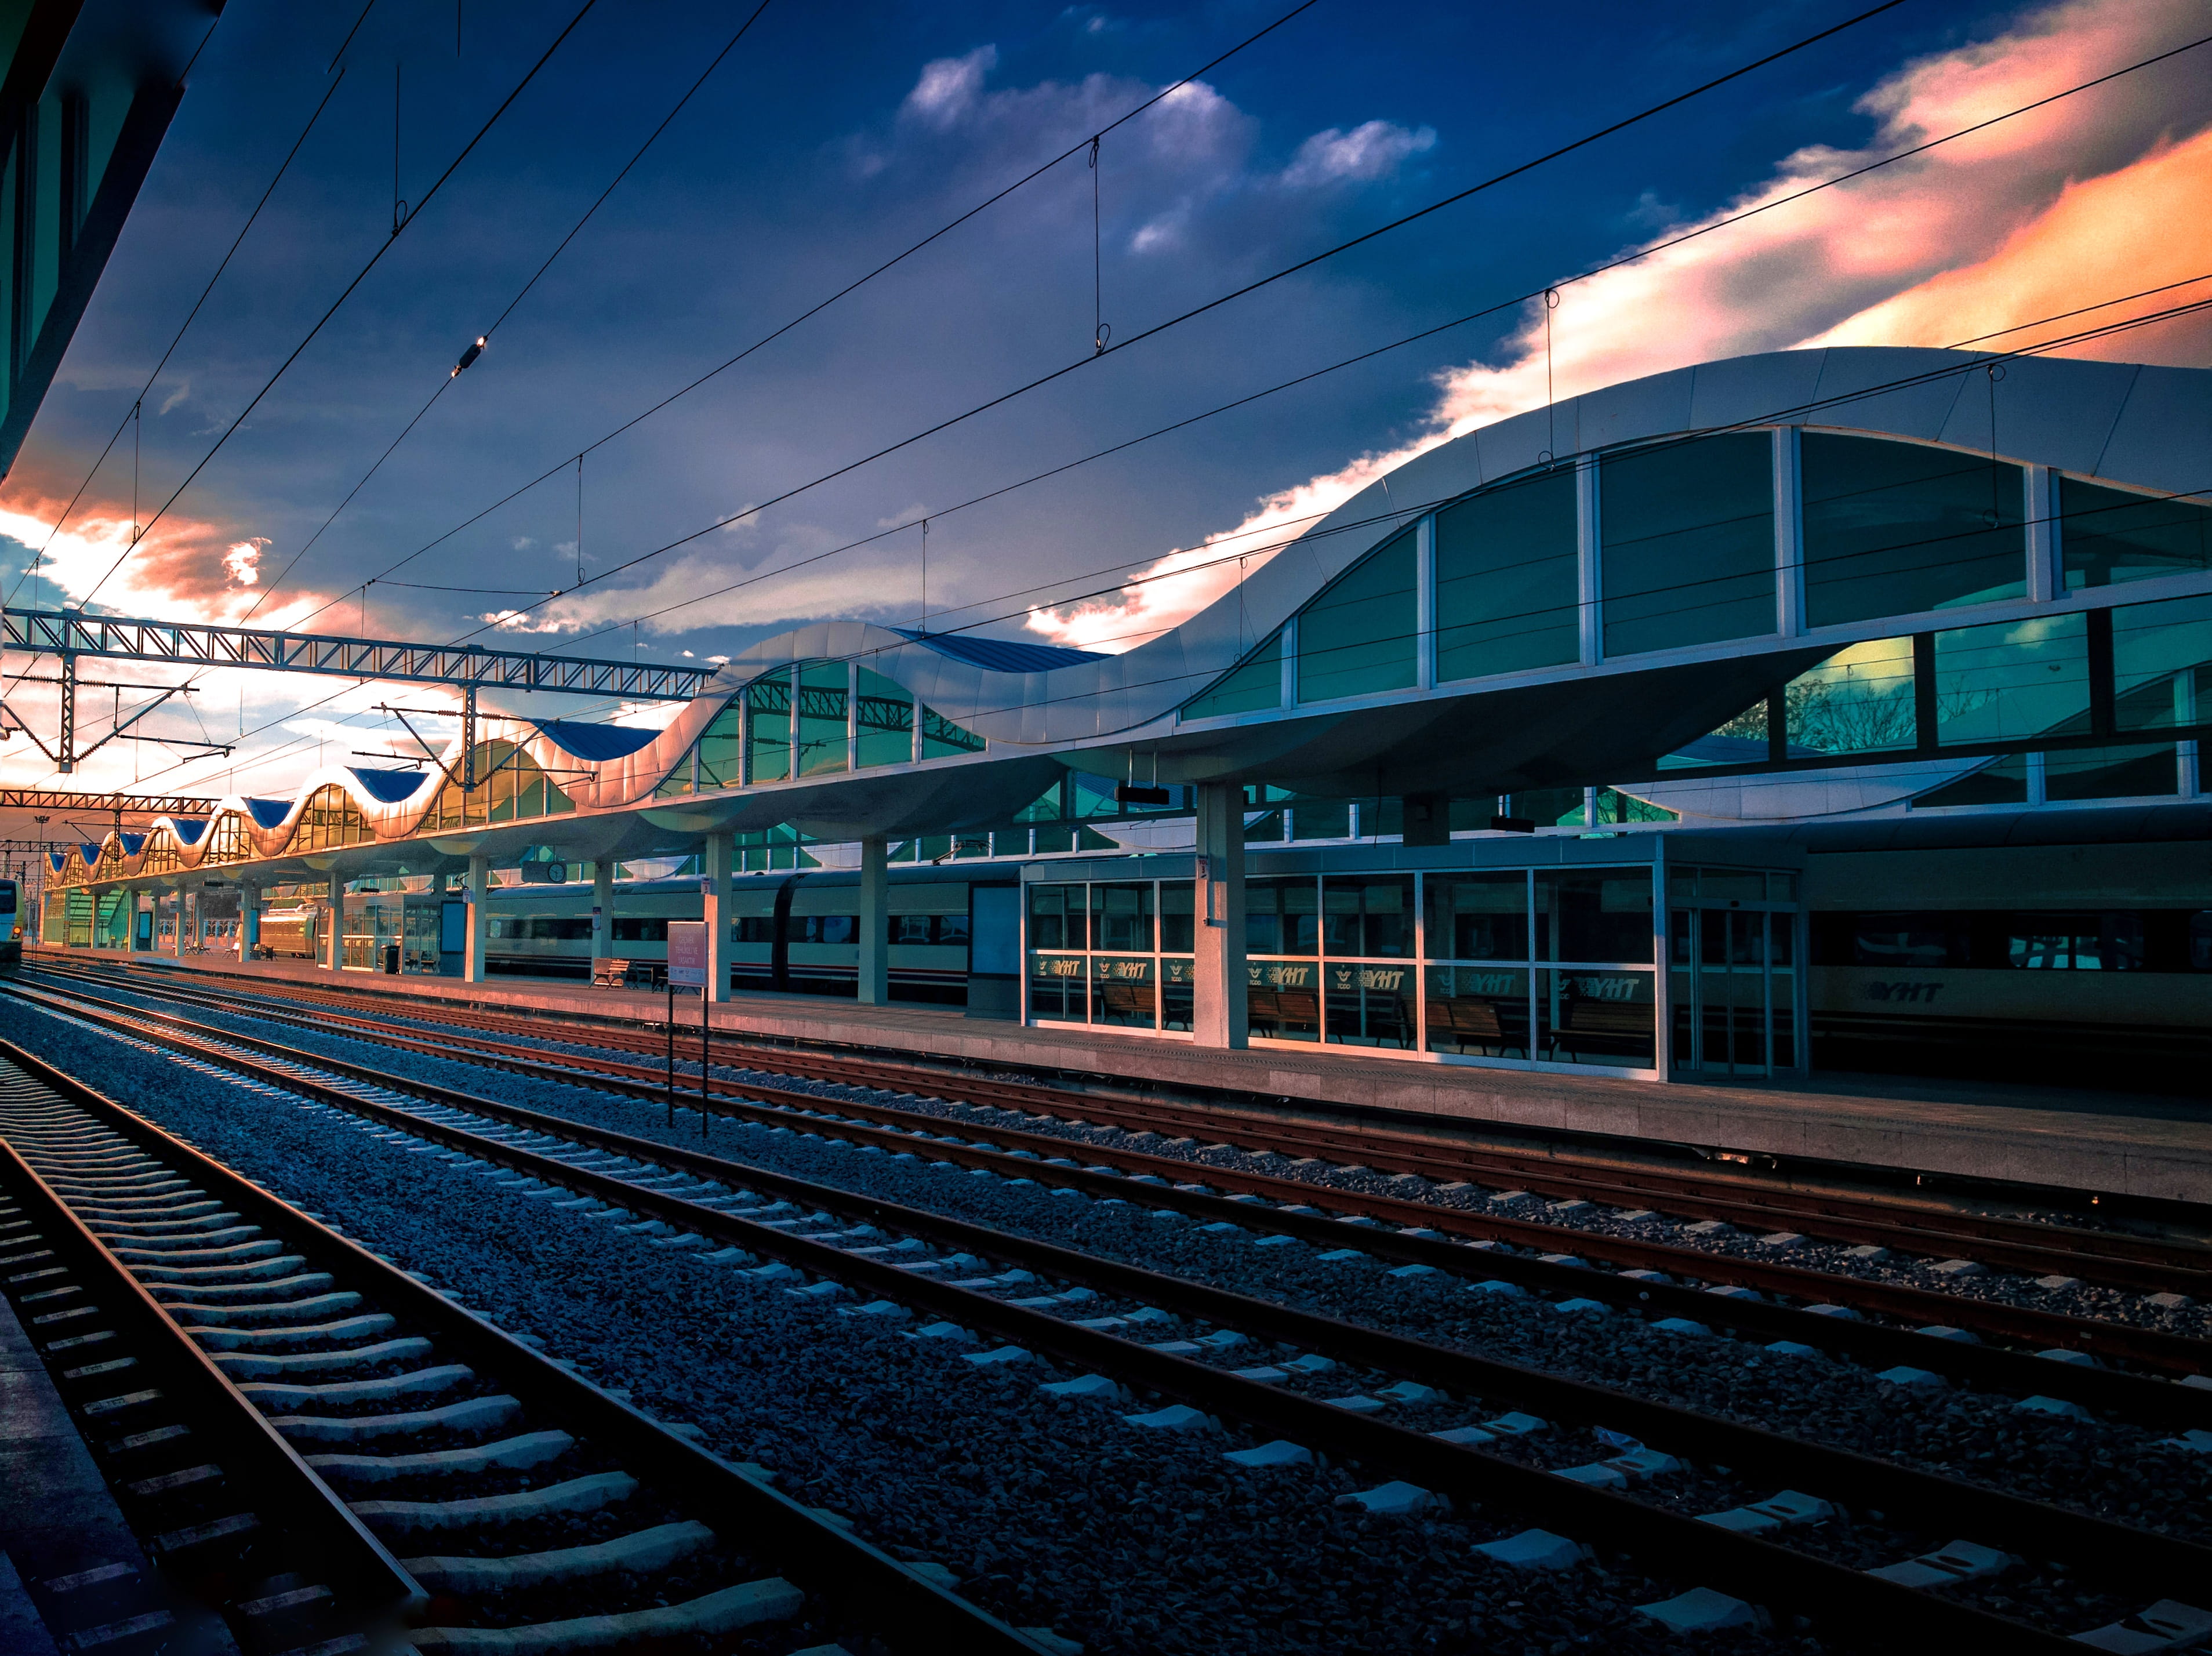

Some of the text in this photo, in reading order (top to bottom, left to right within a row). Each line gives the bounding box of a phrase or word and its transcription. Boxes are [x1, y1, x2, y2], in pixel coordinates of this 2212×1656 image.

[1058, 960, 1080, 976] YHT
[1120, 962, 1147, 979] YHT
[1278, 967, 1309, 985] YHT
[1369, 970, 1404, 990] YHT
[1477, 974, 1516, 994] YHT
[1594, 978, 1640, 1000] YHT
[1880, 982, 1944, 1003] YHT
